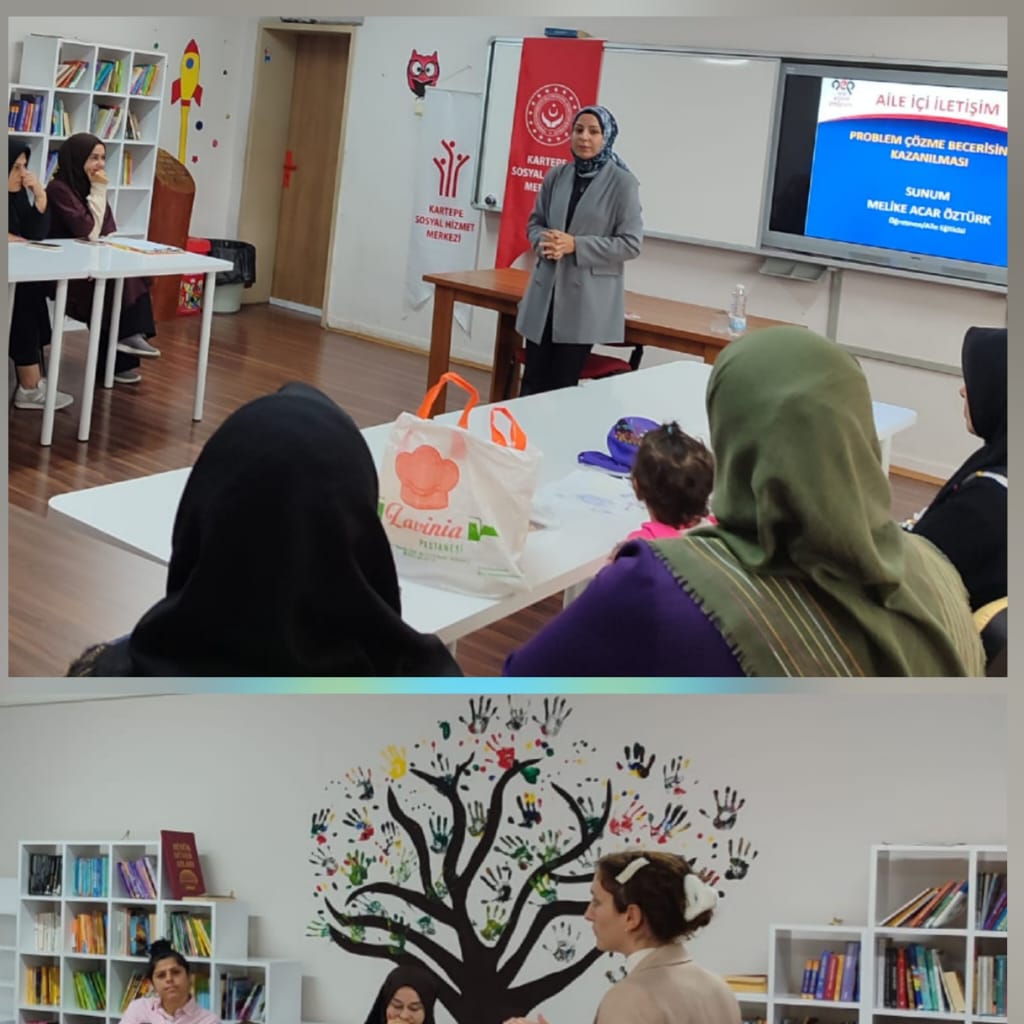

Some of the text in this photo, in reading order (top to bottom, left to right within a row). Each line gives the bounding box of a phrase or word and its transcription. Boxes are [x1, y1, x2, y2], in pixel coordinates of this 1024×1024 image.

[876, 92, 1000, 117] AİLE İÇİ İLETİŞİM
[849, 131, 903, 145] PROBLEM
[904, 134, 945, 150] ÇÖZME
[890, 149, 969, 167] KAZANILMASI
[511, 166, 544, 180] SOSYAL
[905, 186, 951, 201] SUNUM
[429, 204, 464, 218] KARTEPE
[867, 199, 992, 226] MELİKE ACAR ÖZTÜRK
[415, 215, 475, 232] SOSYAL HİZMET
[426, 229, 462, 243] MERKEZİ
[385, 502, 464, 539] Lavinia
